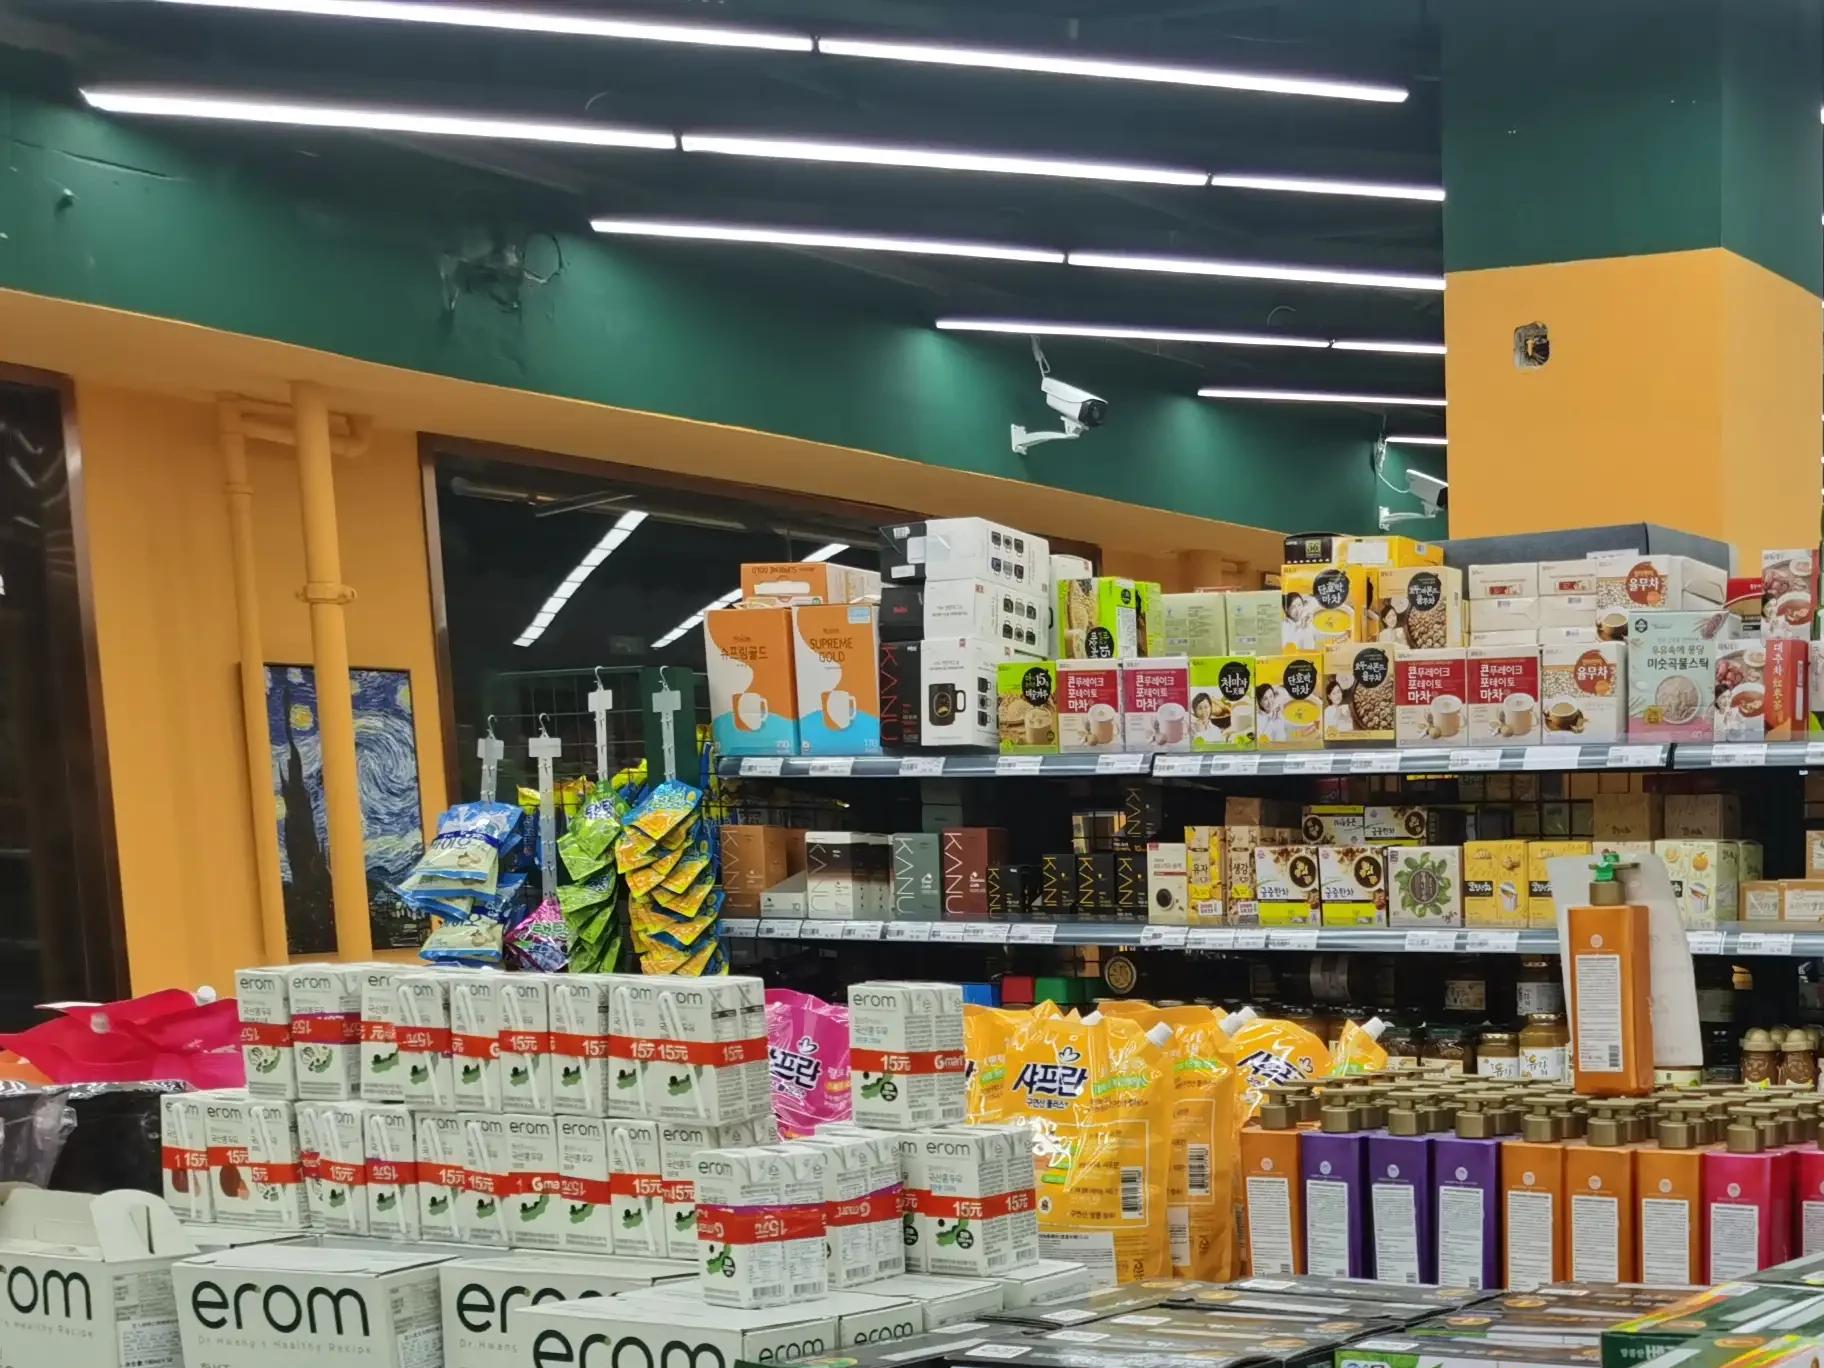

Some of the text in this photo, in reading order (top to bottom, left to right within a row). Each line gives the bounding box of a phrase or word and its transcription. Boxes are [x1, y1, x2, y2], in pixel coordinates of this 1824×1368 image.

[1629, 577, 1659, 591] 율무차
[810, 637, 853, 650] SUPREME
[819, 652, 846, 662] GOLD
[1577, 667, 1608, 680] 율무차
[881, 643, 899, 741] KANU
[1407, 690, 1432, 703] 마차
[1480, 689, 1505, 702] 마차
[1135, 697, 1159, 710] 마차
[895, 837, 915, 915] KANU
[943, 832, 963, 915] KANU
[239, 978, 275, 991] erom
[293, 975, 331, 990] erom
[853, 992, 896, 1008] erom
[511, 1034, 539, 1051] 15元
[657, 1046, 688, 1061] 15元
[880, 1055, 911, 1072] 15元
[207, 1105, 242, 1119] erom
[510, 1121, 549, 1136] erom
[926, 1141, 970, 1157] erom
[699, 1160, 733, 1176] erom
[952, 1200, 983, 1218] 15元
[192, 1280, 370, 1337] erom
